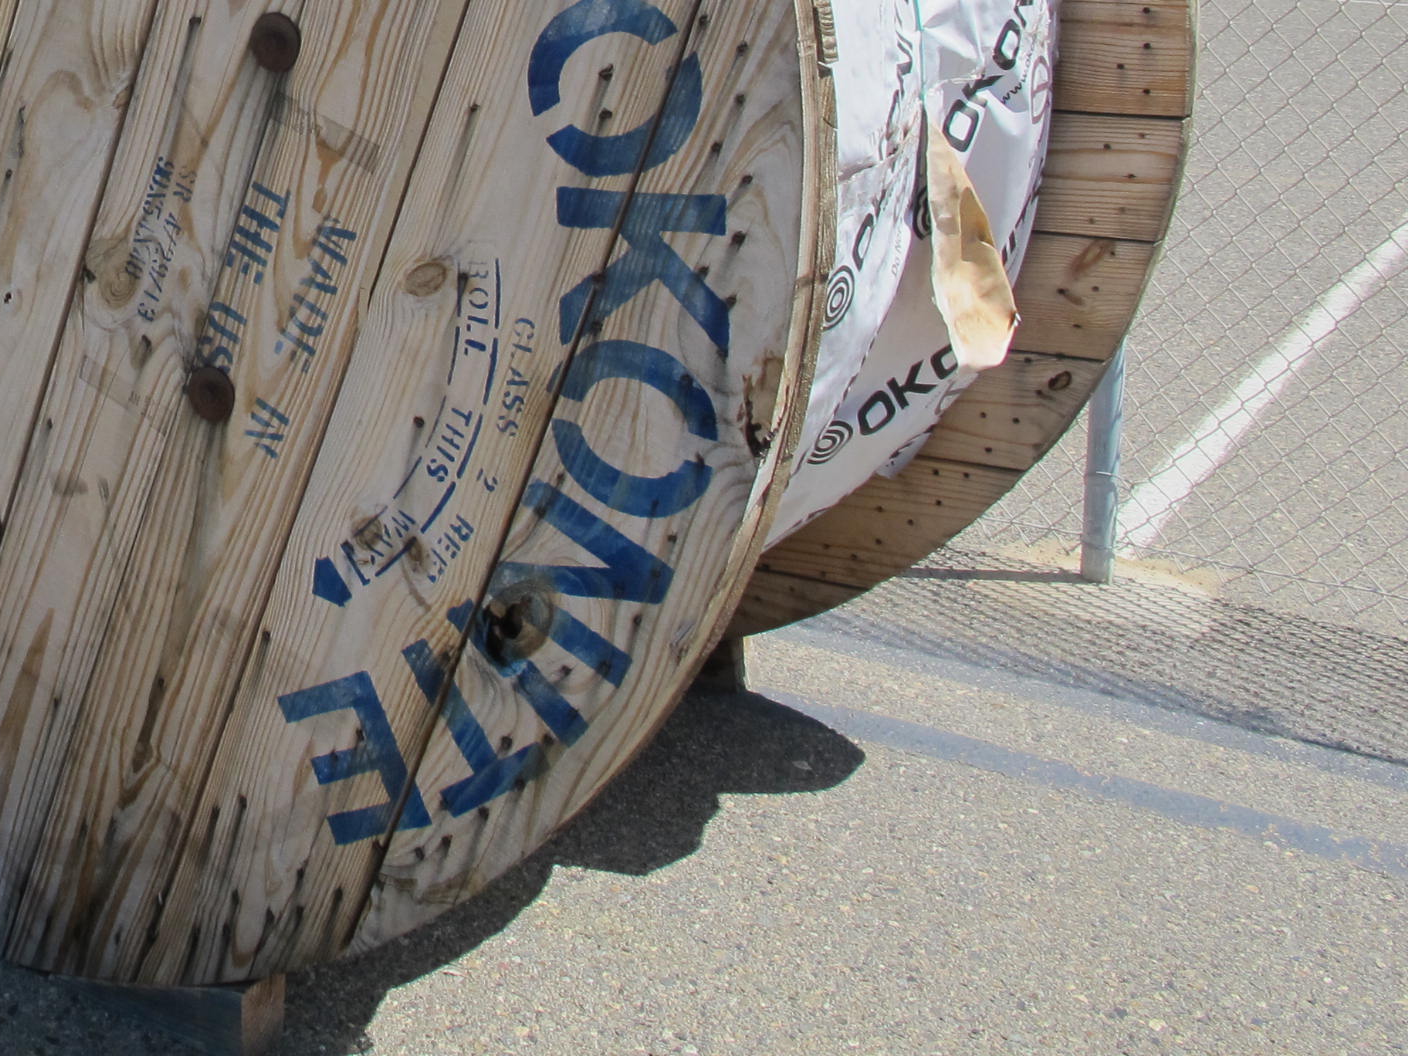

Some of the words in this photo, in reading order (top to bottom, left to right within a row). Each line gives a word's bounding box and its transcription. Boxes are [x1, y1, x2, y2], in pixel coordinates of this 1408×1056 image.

[225, 181, 291, 285] THE
[273, 214, 357, 374] MADE
[245, 397, 290, 459] IN
[496, 317, 536, 438] CLASS
[425, 406, 474, 484] THIS
